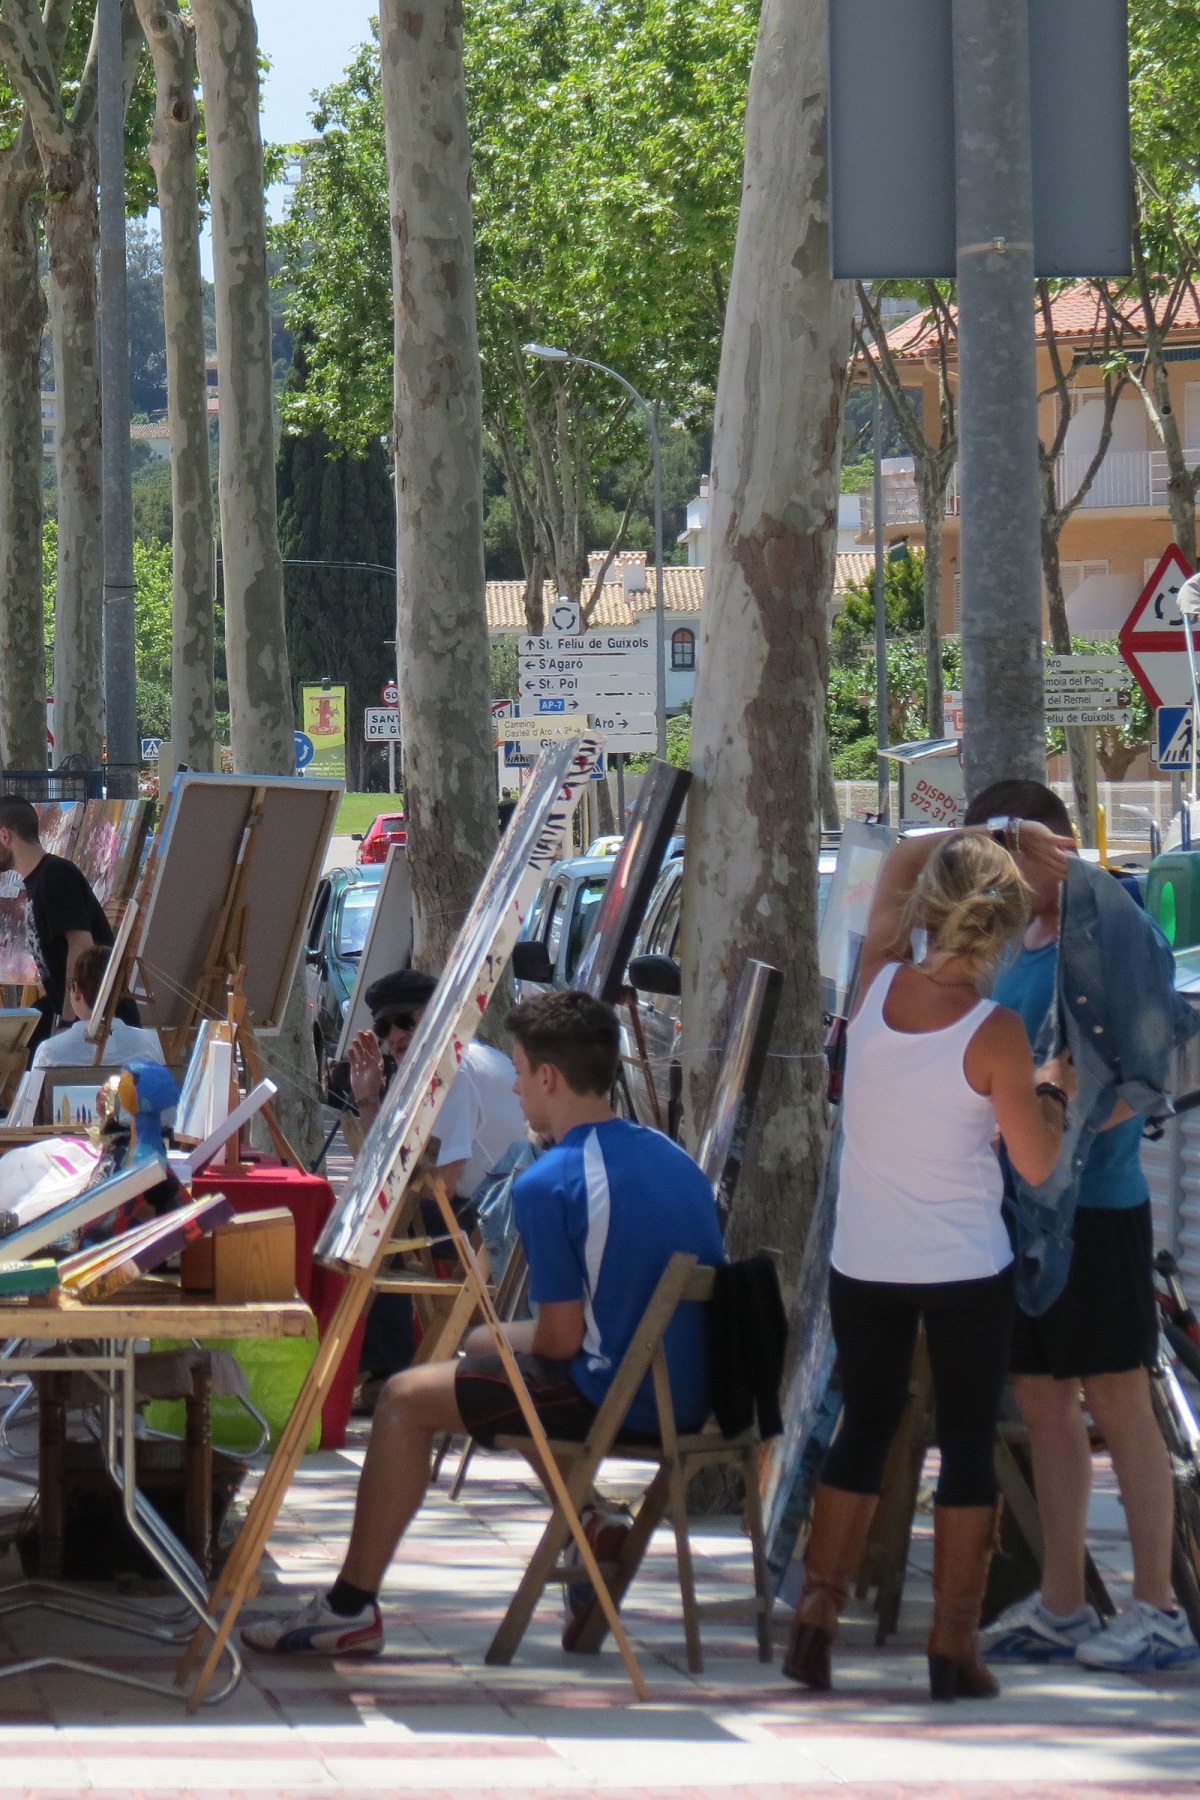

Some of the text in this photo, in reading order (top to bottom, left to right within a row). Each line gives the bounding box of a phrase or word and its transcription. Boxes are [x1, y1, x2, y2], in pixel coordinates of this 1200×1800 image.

[539, 637, 649, 649] St. Feliu de Guíxols
[539, 658, 583, 672] S'Agaró
[539, 678, 578, 689] St. Pol
[1070, 676, 1082, 686] del
[1085, 676, 1104, 687] Puig
[385, 691, 398, 699] 50
[1047, 695, 1092, 705] del Remei
[541, 700, 562, 710] AP-7
[1067, 713, 1078, 722] de
[504, 720, 536, 728] Camping
[370, 726, 384, 734] DE
[505, 728, 530, 738] Castell
[910, 792, 932, 813] 972
[932, 807, 947, 822] 31
